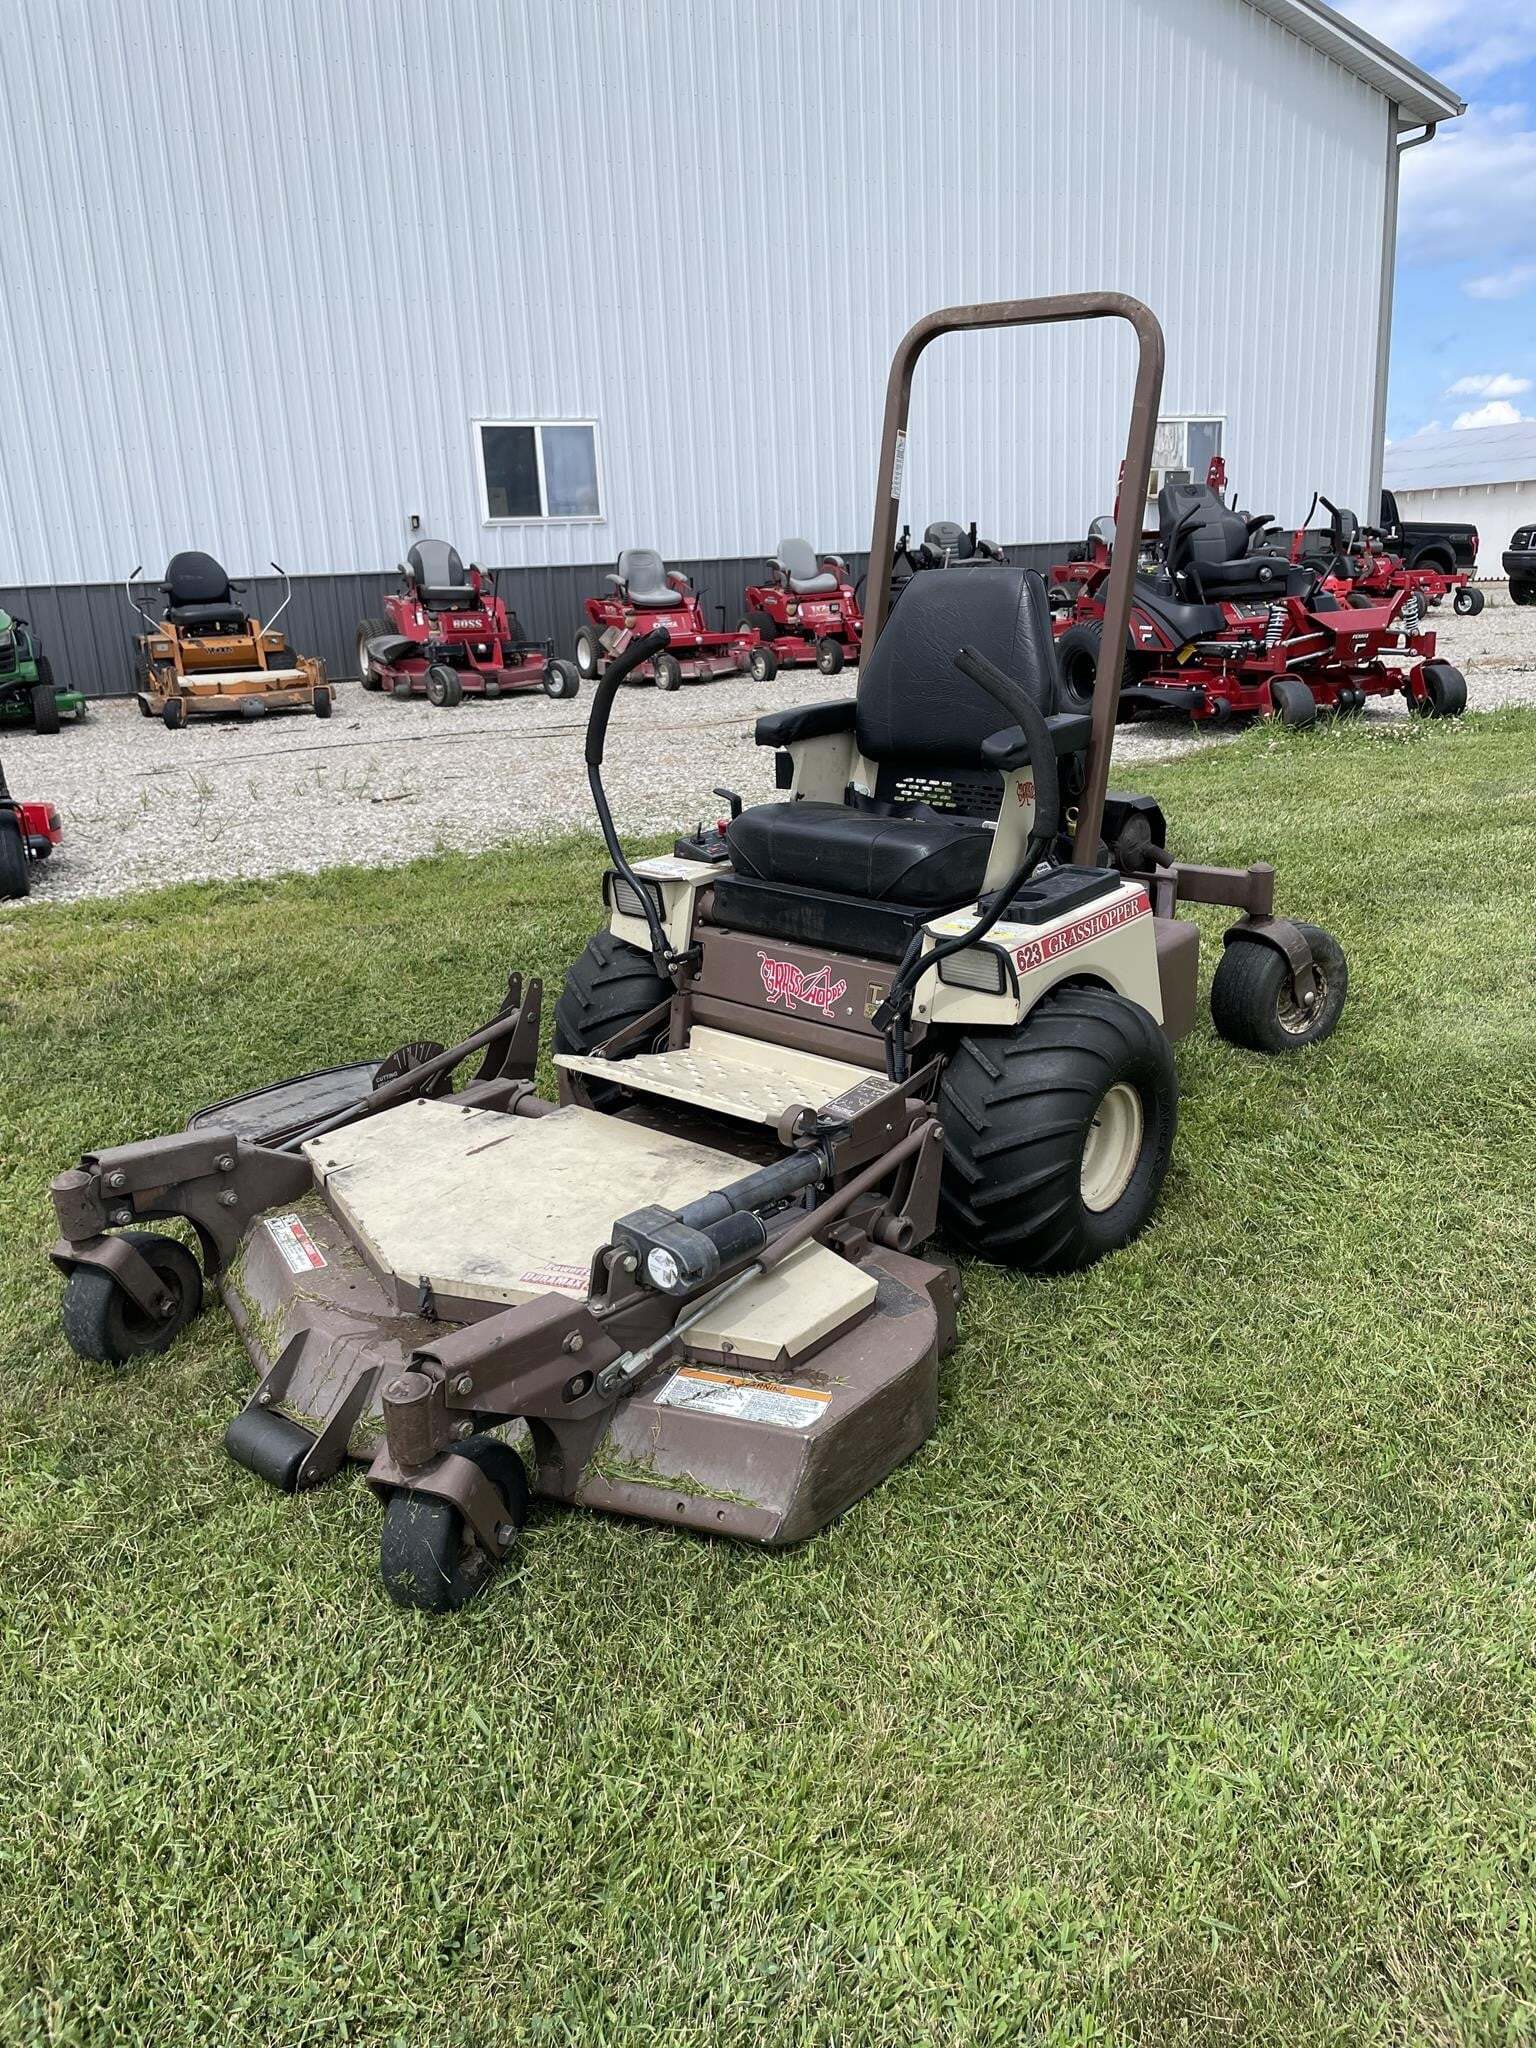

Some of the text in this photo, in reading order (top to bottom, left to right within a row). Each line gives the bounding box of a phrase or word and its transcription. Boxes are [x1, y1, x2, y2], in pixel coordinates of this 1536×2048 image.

[452, 619, 483, 629] BOSS
[1016, 899, 1139, 971] 623 GRASSHOPPER
